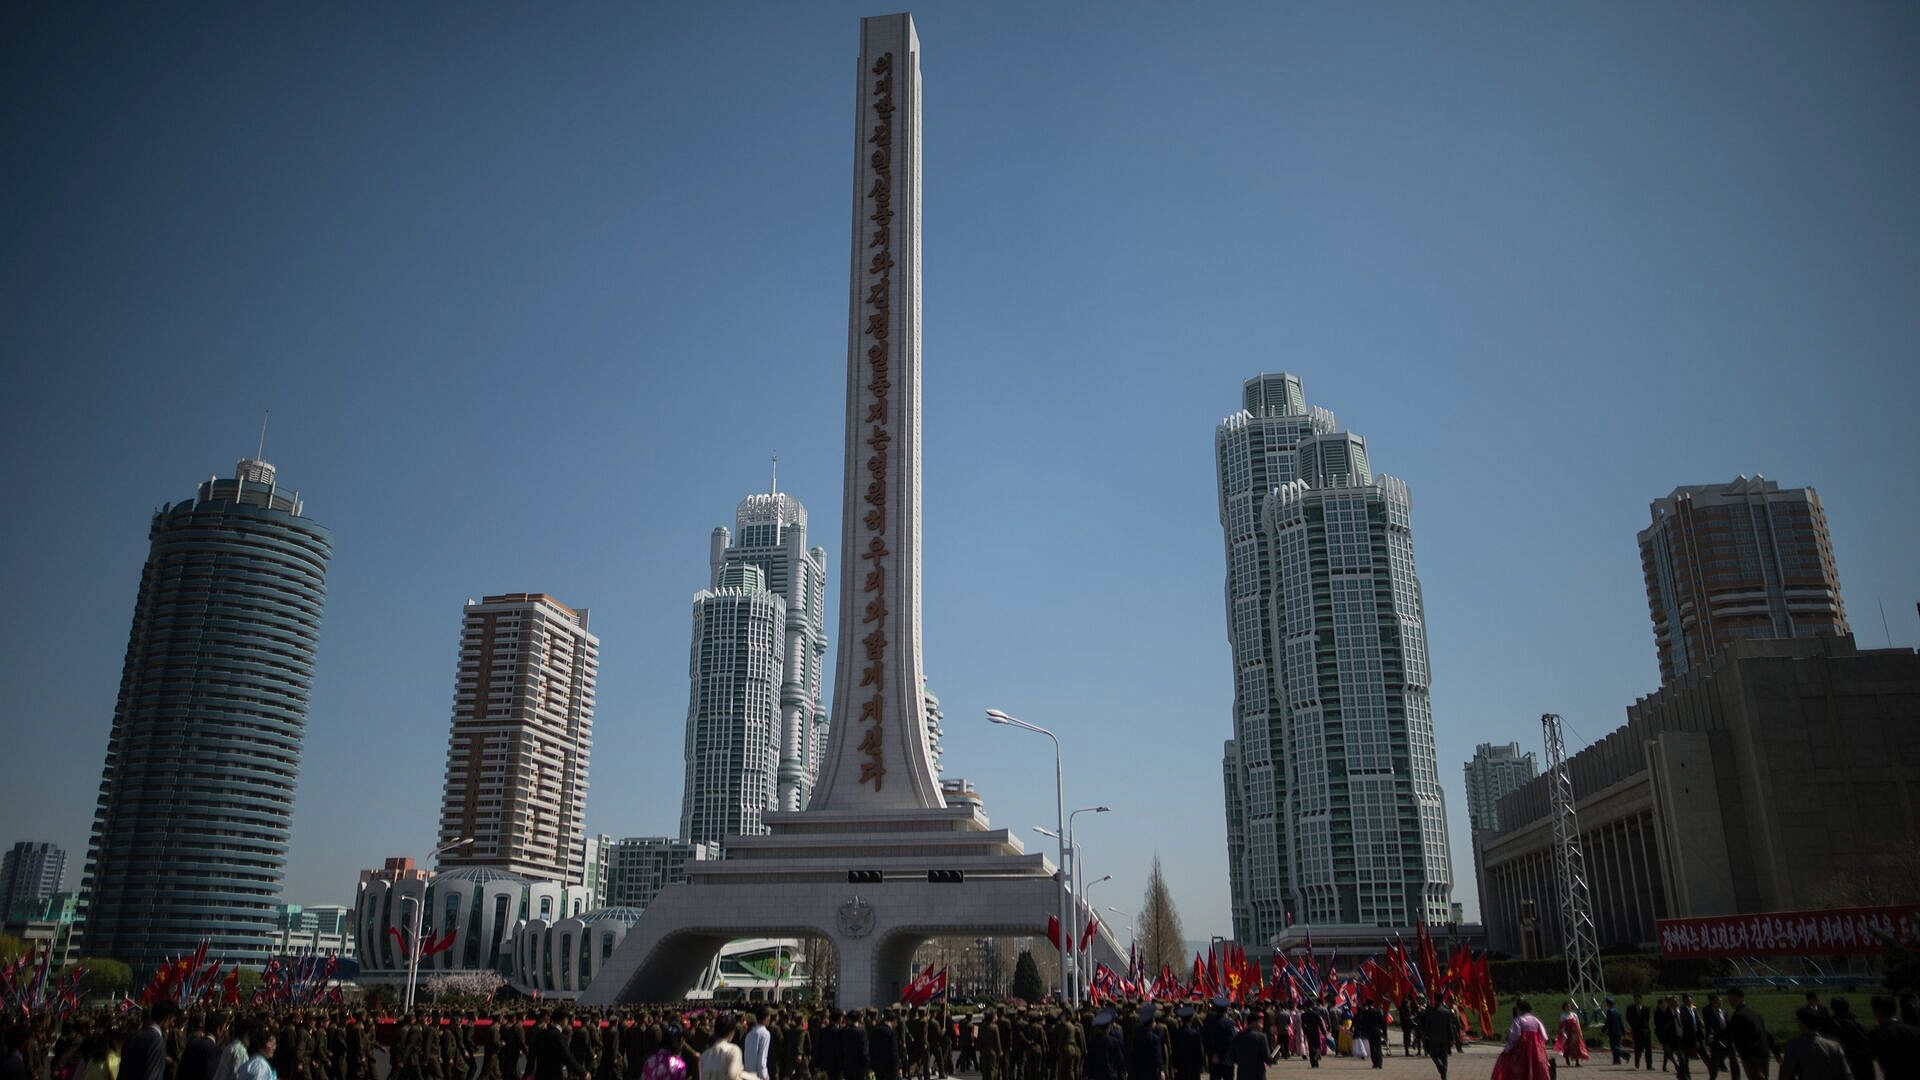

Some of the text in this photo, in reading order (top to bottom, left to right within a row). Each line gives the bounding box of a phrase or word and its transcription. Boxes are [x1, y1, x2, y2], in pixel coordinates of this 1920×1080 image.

[867, 119, 895, 279] 김일성동지와
[865, 278, 892, 452] 김정일동지는
[863, 452, 888, 537] 영원히
[861, 537, 890, 630] 우리와
[859, 630, 888, 692] 함께
[857, 693, 887, 794] 계신다
